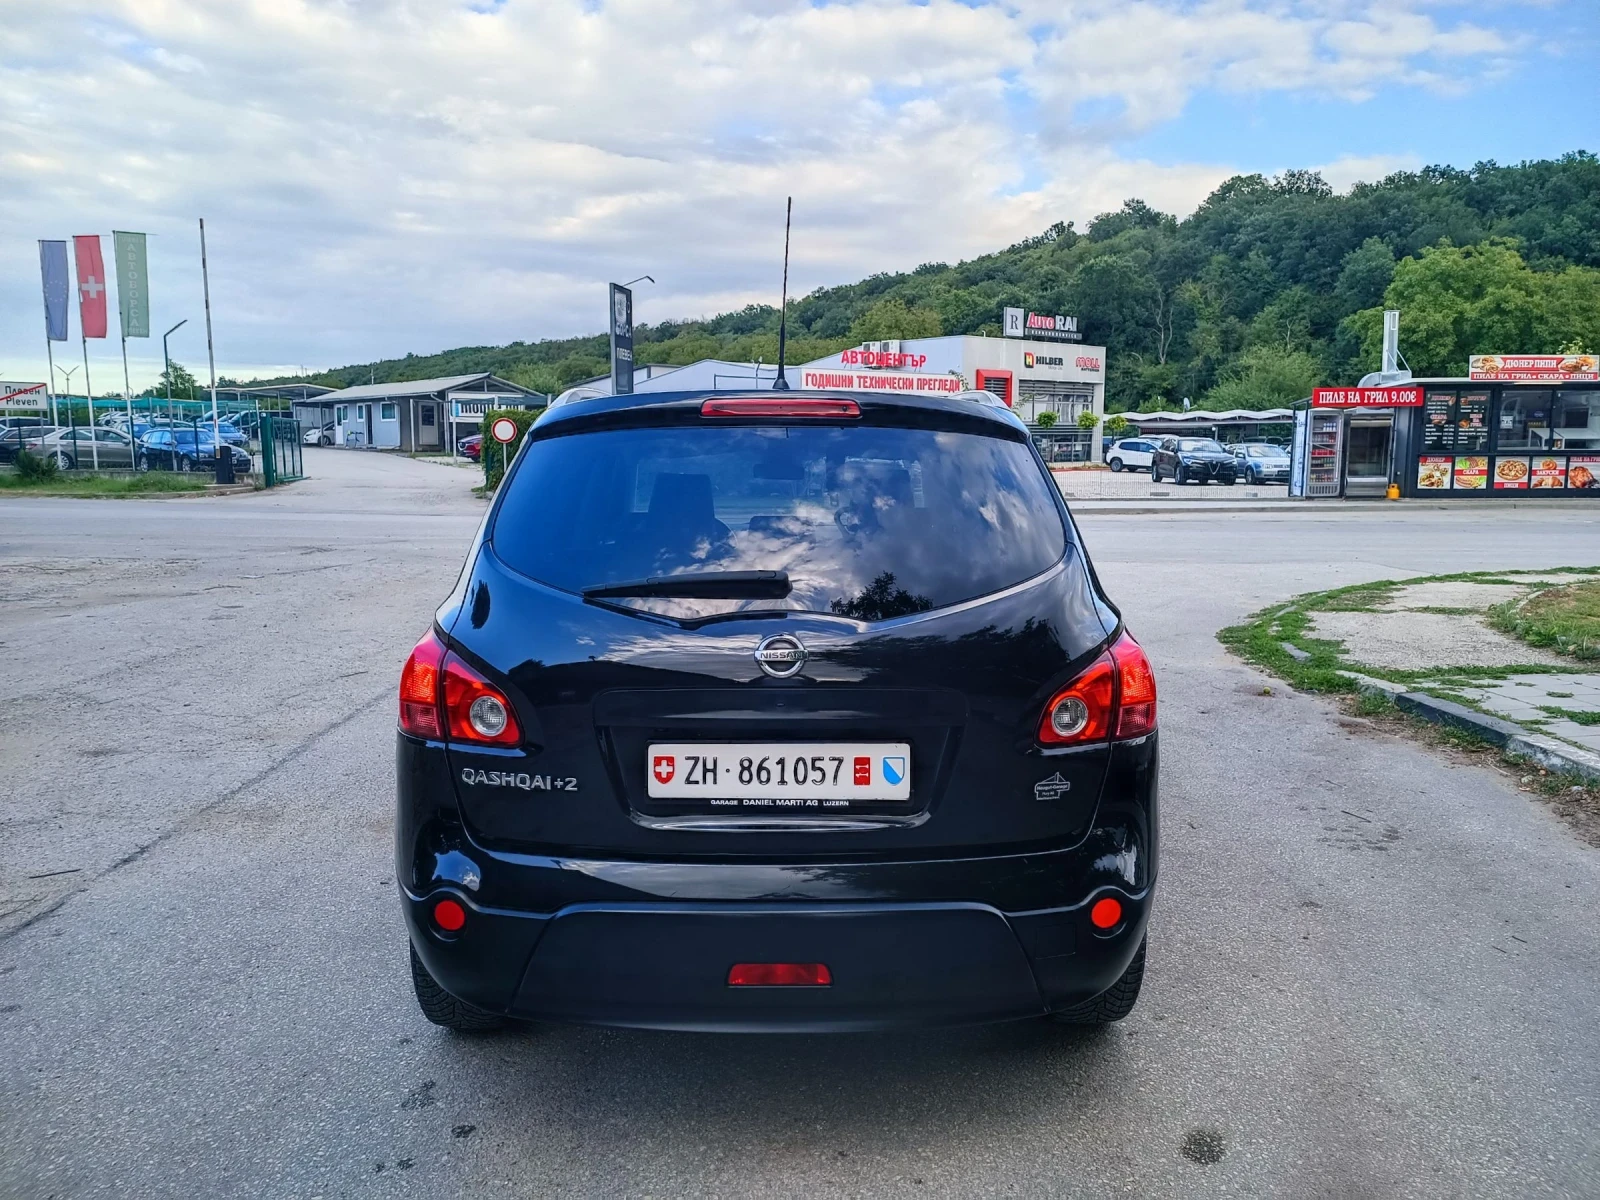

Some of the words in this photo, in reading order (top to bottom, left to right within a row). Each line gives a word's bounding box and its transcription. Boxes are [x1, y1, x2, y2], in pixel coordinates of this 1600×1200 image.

[1055, 315, 1077, 332] RAI
[841, 350, 926, 368] АВТОЦЕНТЪР
[1036, 356, 1063, 366] HILBER
[1505, 360, 1533, 368] ДЮНЕР
[805, 373, 854, 389] ГОДИШНИ
[856, 375, 914, 390] ТЕХНИЧЕСКИ
[916, 378, 960, 393] ПРЕГЛЕДИ
[6, 397, 38, 406] Pleven
[1319, 392, 1345, 404] ПИЛЕ
[1348, 392, 1360, 404] НА
[1364, 392, 1388, 403] ГРИЛ
[1391, 391, 1416, 402] 9.00€
[760, 651, 803, 659] NISSAN
[684, 756, 718, 785] ZH
[738, 756, 844, 786] 861057
